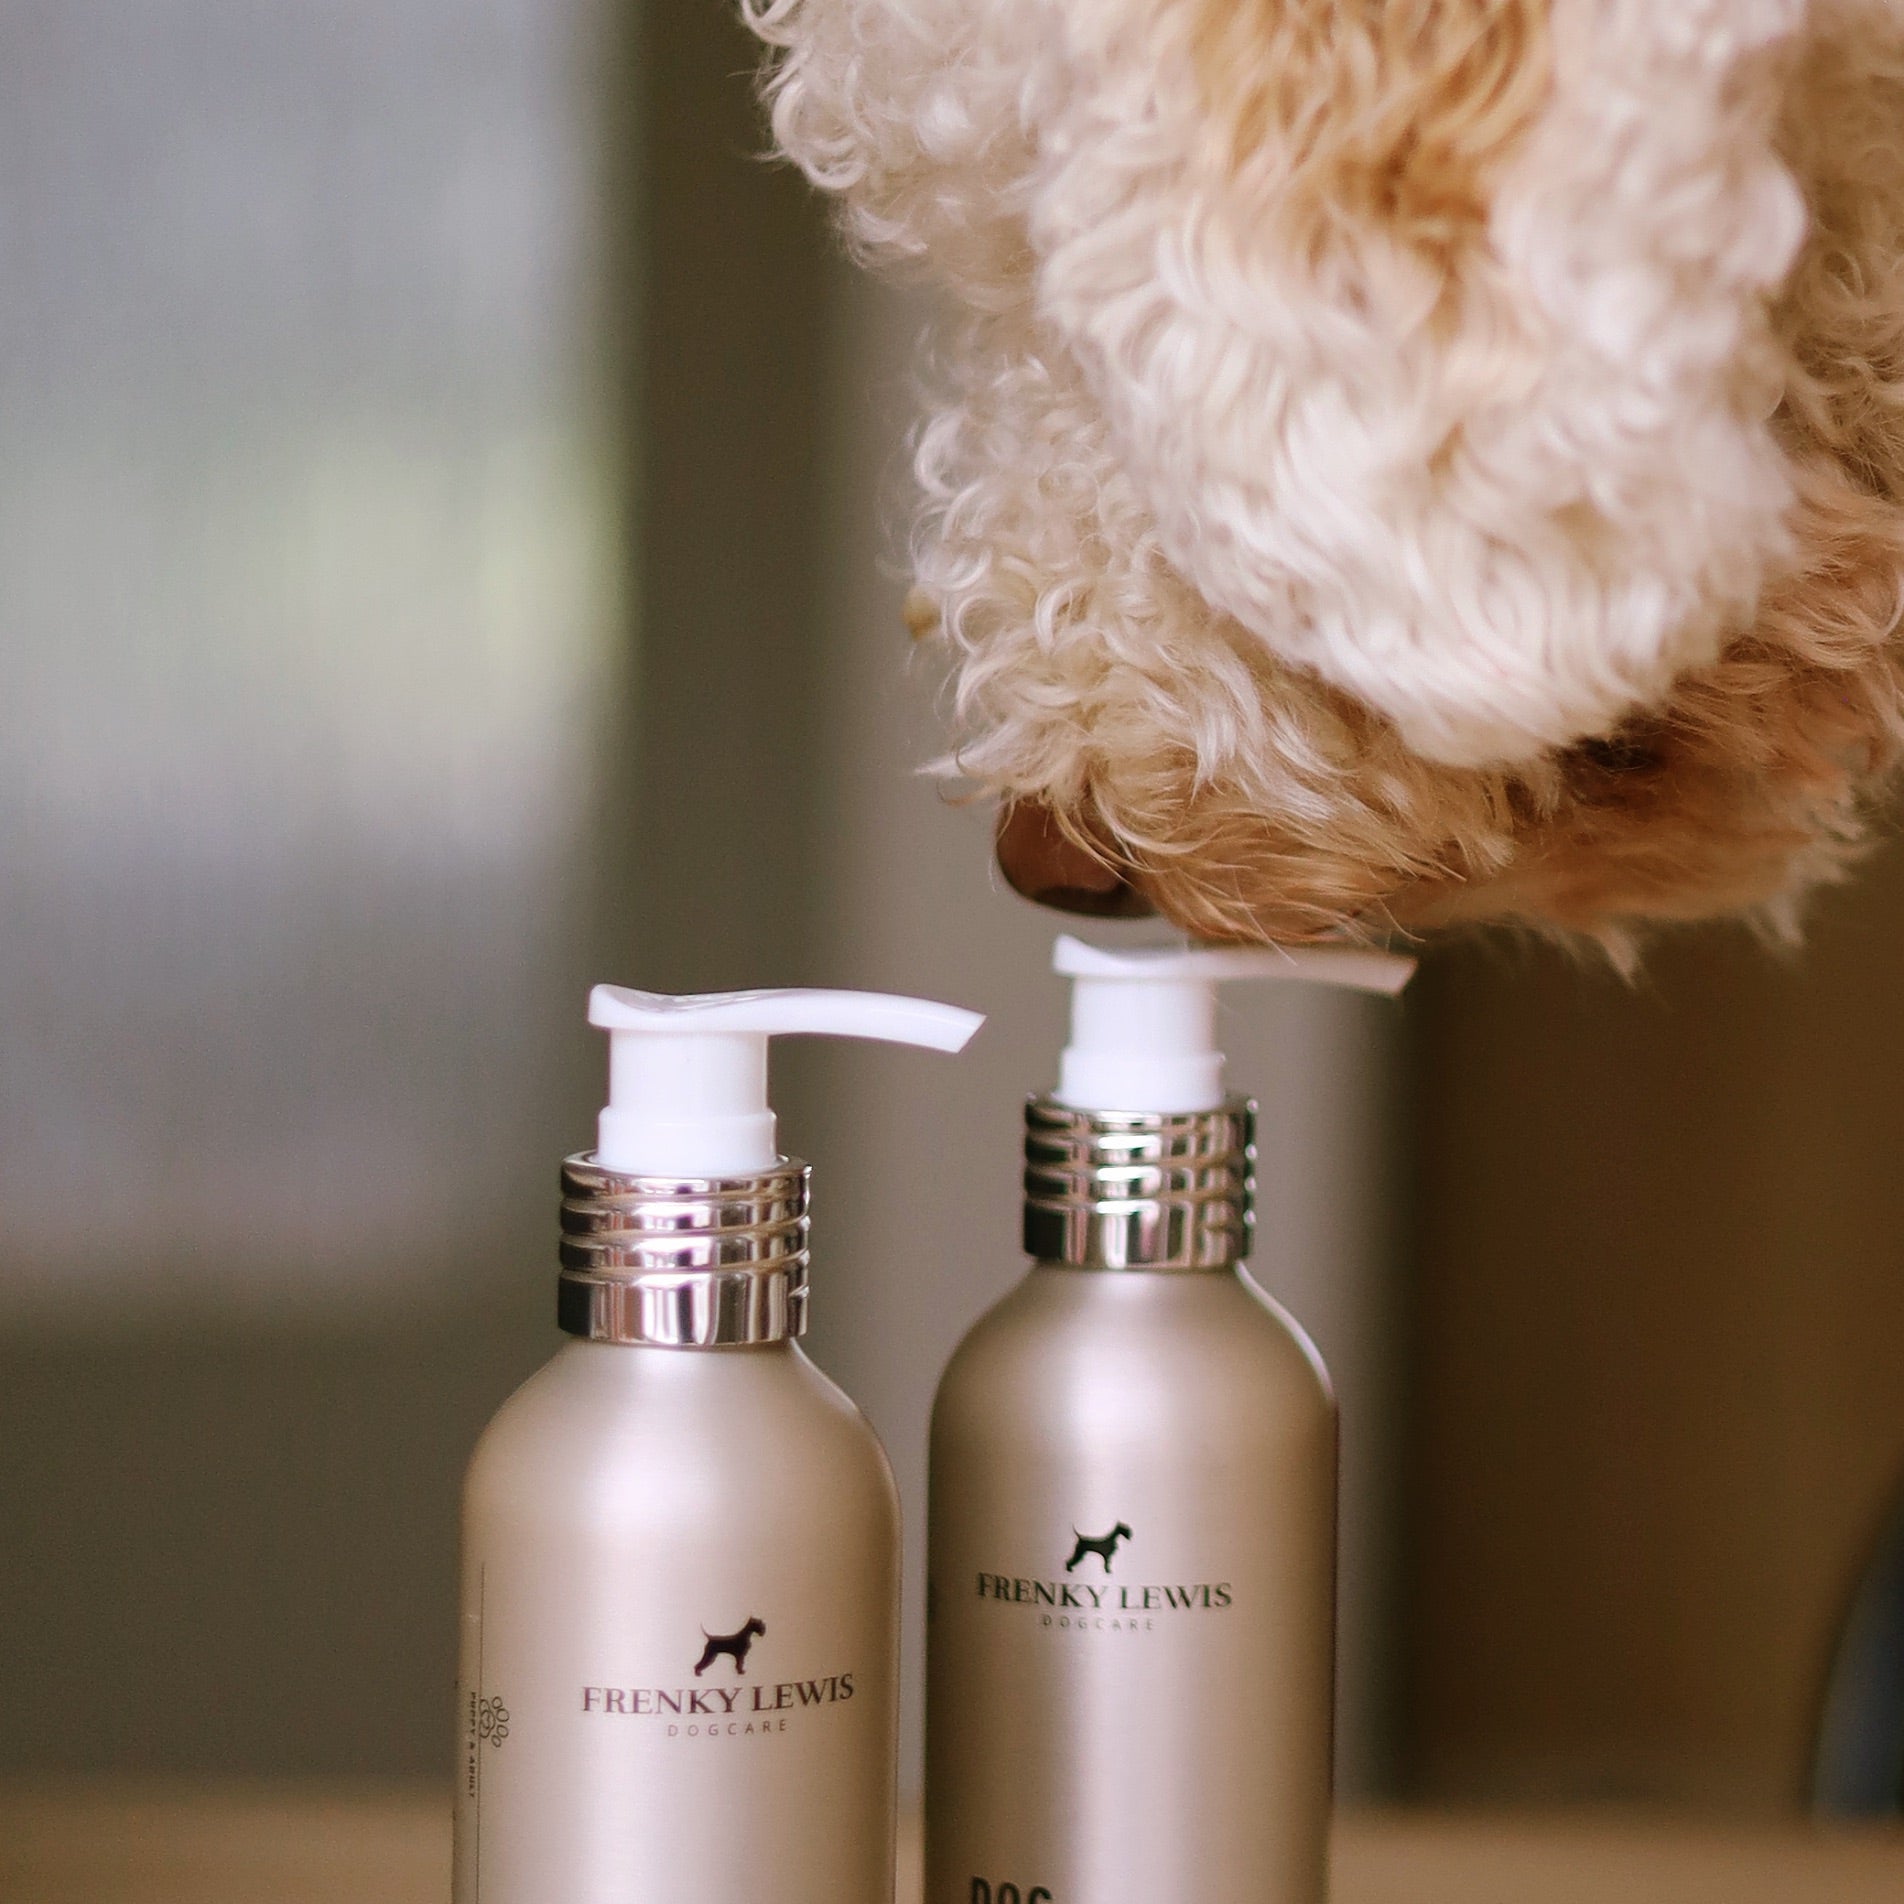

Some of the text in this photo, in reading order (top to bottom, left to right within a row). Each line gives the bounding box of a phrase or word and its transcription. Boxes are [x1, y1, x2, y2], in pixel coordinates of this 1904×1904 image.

[976, 1572, 1233, 1609] FRENKY LEWIS
[1042, 1613, 1154, 1630] DOGCARE
[582, 1673, 854, 1714] FRENKY LEWIS
[668, 1719, 787, 1737] DOGCARE
